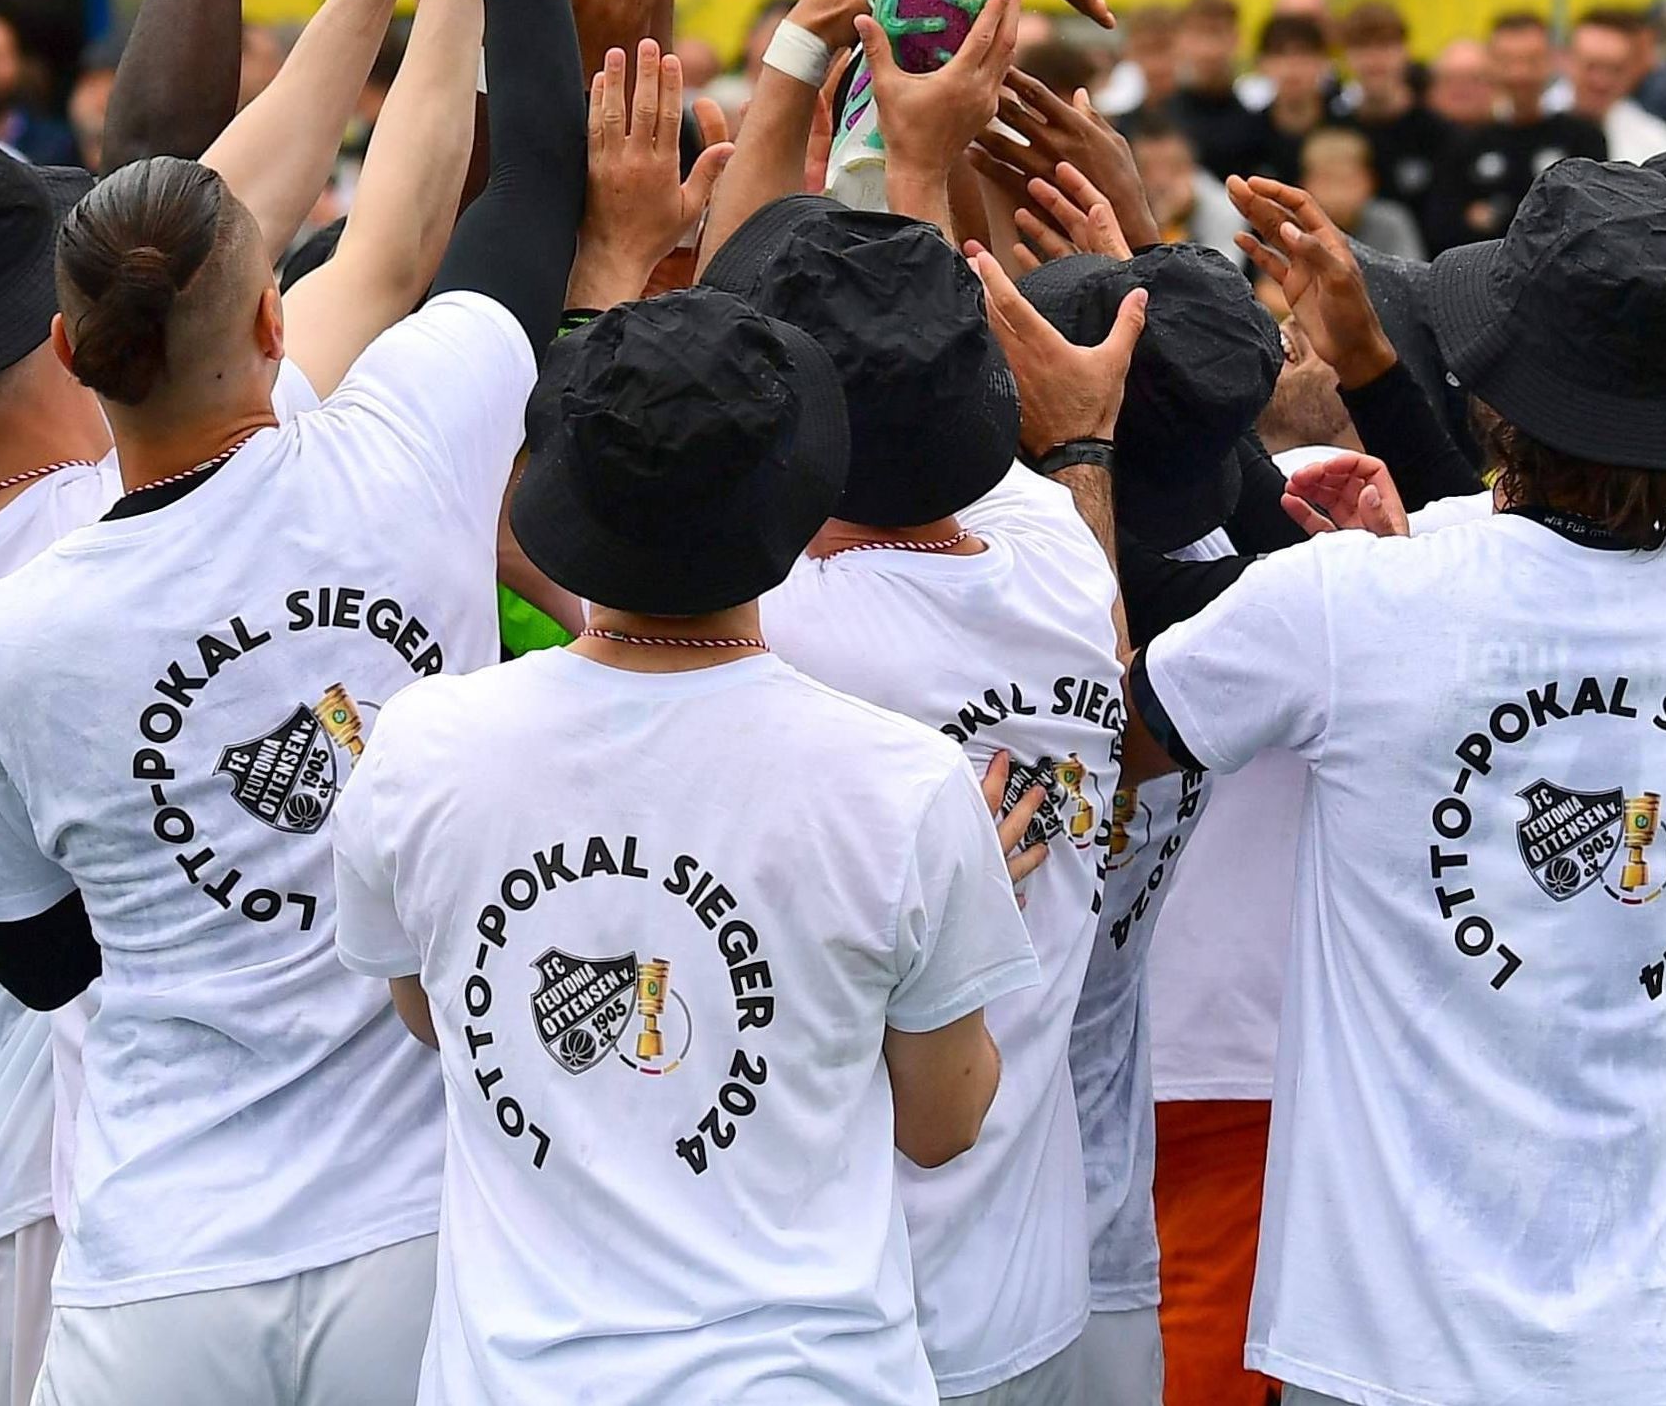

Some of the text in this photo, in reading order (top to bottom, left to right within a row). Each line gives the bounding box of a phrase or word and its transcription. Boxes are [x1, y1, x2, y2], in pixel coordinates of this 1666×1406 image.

[133, 587, 444, 931] LOTTO-POKAL SIEGER
[227, 751, 250, 773] FC
[239, 738, 283, 802] TEUTONIA
[258, 730, 305, 816] OTTENSEN
[300, 747, 329, 789] 1905
[1522, 795, 1584, 842] TEUTONIA
[1531, 788, 1553, 811] FC
[1430, 677, 1638, 990] LOTTO-POKAL
[1529, 804, 1609, 862] OTTENSEN
[1576, 830, 1615, 864] 1905
[535, 963, 597, 1015] TEUTONIA
[543, 956, 566, 981] FC
[465, 836, 774, 1175] LOTTO-POKAL SIEGER 2024
[542, 970, 621, 1036] OTTENSEN
[591, 998, 627, 1033] 1905
